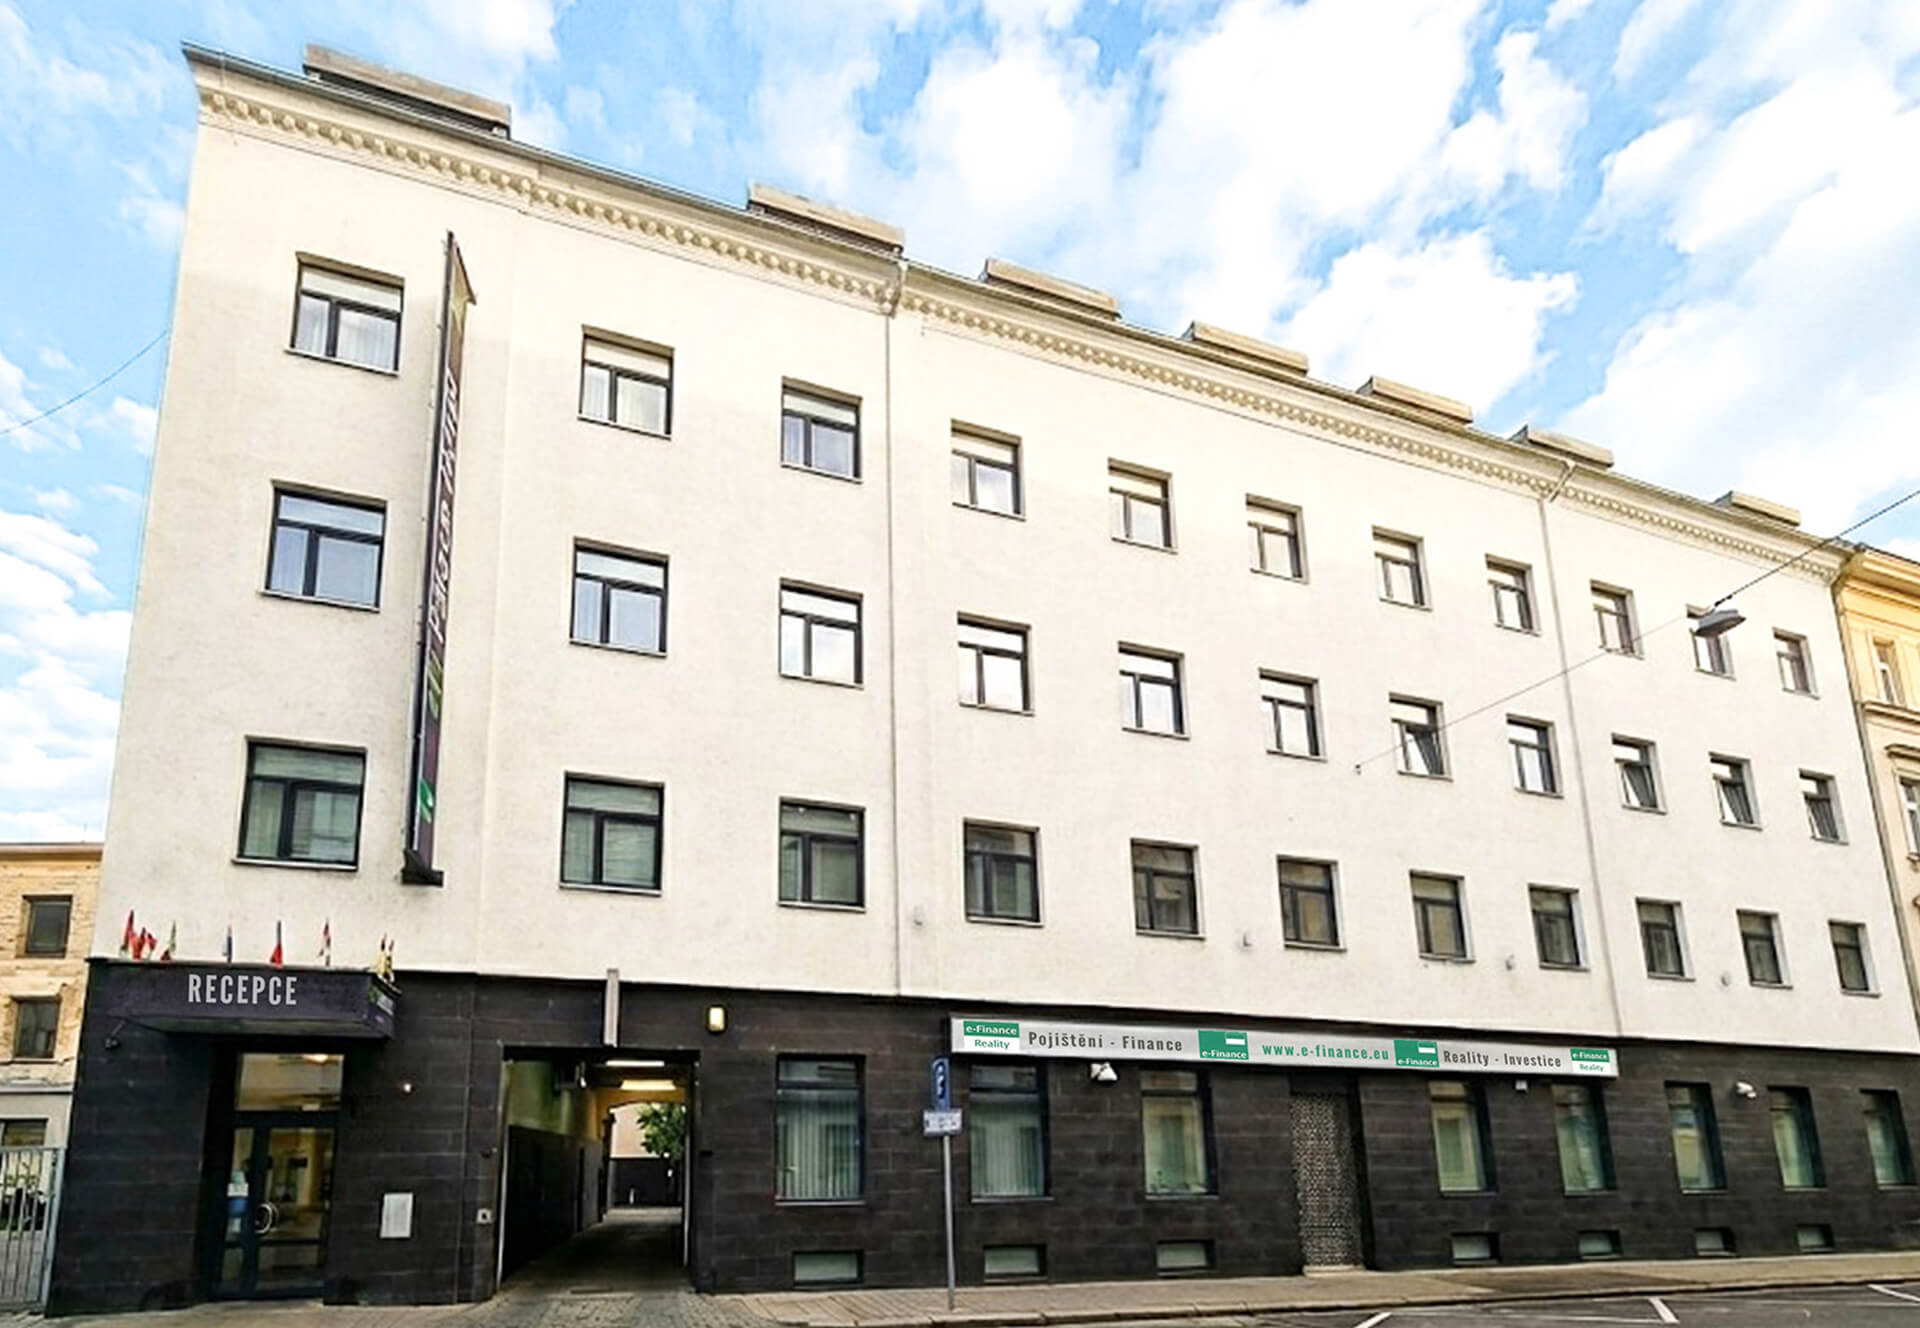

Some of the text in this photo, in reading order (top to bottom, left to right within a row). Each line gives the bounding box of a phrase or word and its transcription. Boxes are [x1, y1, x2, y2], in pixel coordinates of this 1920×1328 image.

[188, 974, 297, 1005] RECEPCE
[965, 1024, 1018, 1036] e-Finance
[974, 1038, 1010, 1050] Reality
[1122, 1035, 1183, 1052] Finance
[1201, 1049, 1248, 1060] e-Finance
[1261, 1043, 1390, 1061] www.e-finance.eu
[1571, 1050, 1608, 1061] e-Finance
[1397, 1057, 1439, 1068] e-Finance
[1443, 1050, 1489, 1068] Reality
[1504, 1053, 1562, 1068] Investice
[1578, 1062, 1605, 1073] Reality
